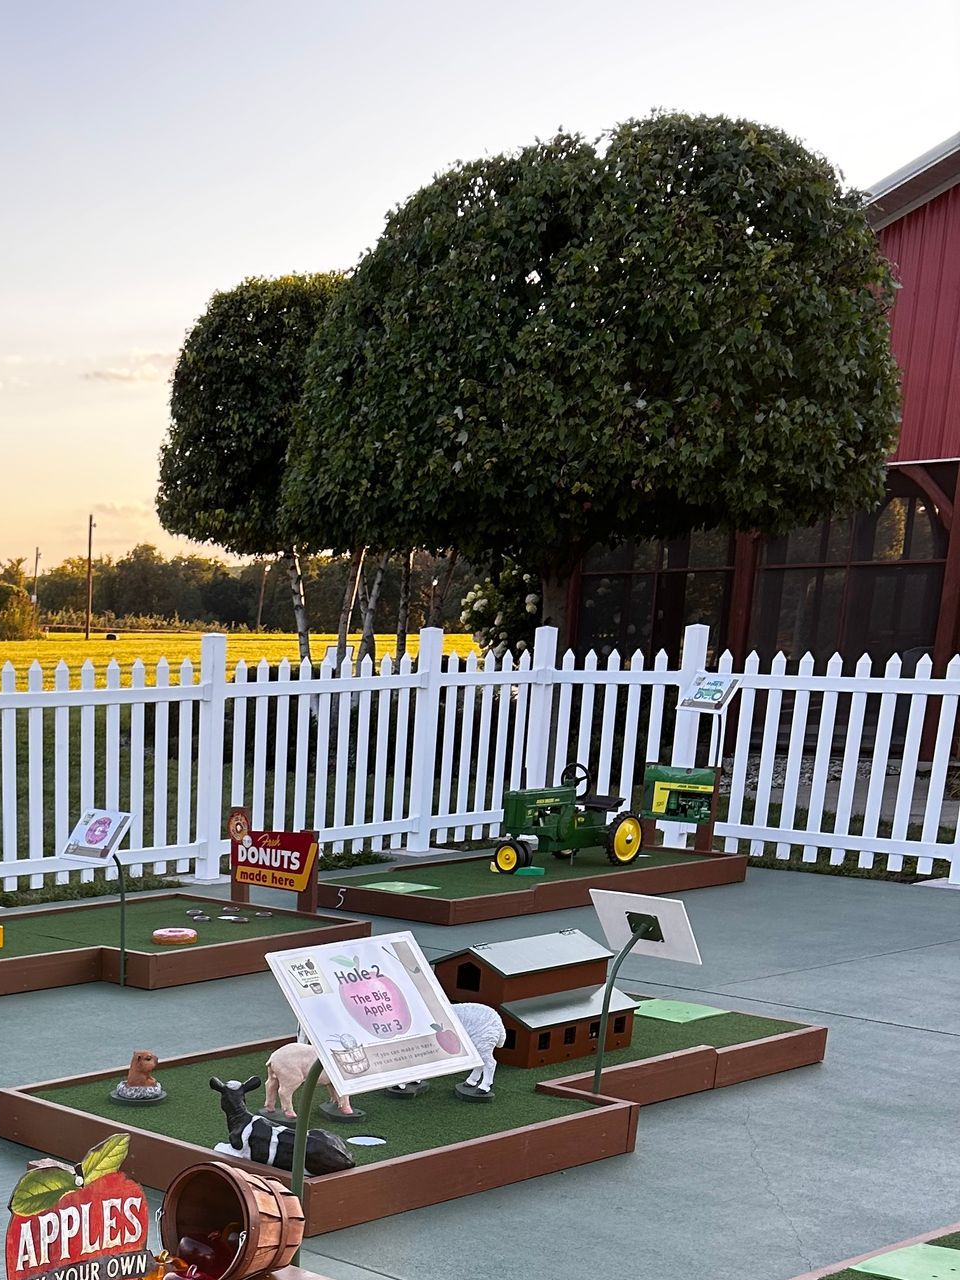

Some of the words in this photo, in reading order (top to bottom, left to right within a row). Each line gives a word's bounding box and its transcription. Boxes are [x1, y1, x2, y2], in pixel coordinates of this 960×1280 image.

[237, 844, 300, 870] DONUTS
[240, 870, 268, 882] made
[271, 872, 295, 887] here
[336, 888, 347, 908] 5
[334, 967, 371, 985] Hole
[371, 964, 385, 978] 2
[350, 994, 372, 1005] The
[371, 990, 391, 1002] Big
[363, 1002, 393, 1017] Apple
[372, 1022, 393, 1035] Par
[392, 1019, 403, 1031] 3
[15, 1197, 142, 1271] APPLES
[106, 1253, 148, 1279] OWN
